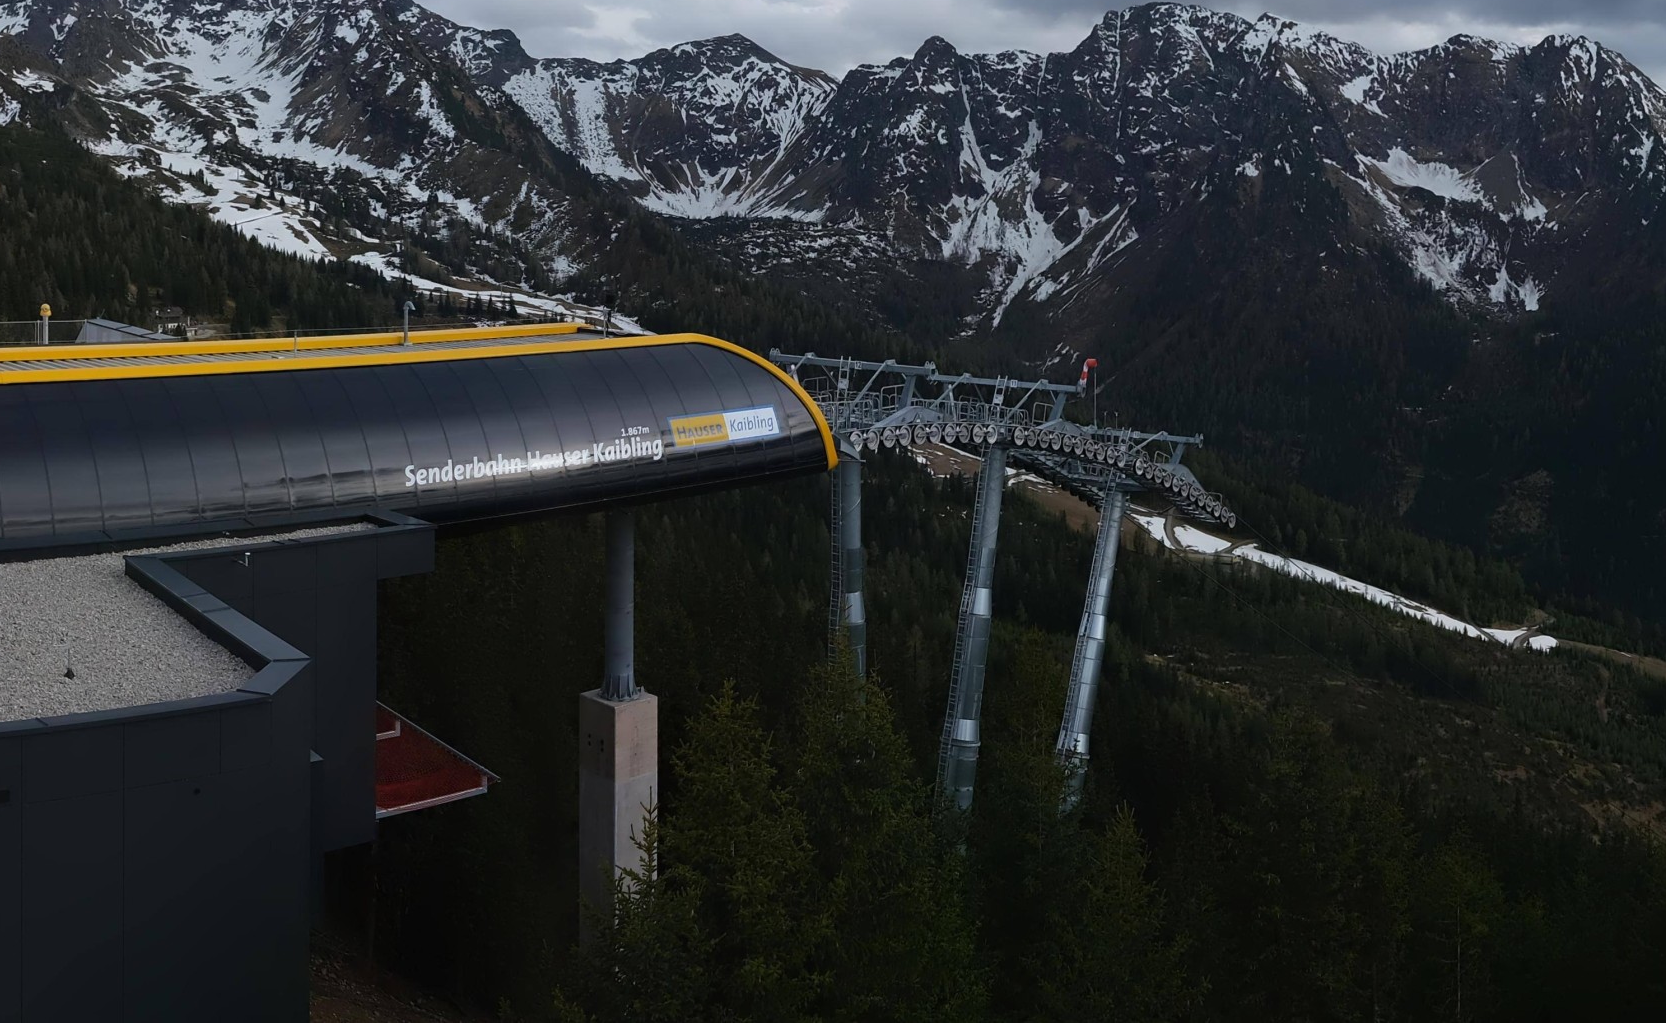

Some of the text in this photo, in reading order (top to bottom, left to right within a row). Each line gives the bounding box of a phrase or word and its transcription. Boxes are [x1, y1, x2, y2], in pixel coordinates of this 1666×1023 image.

[620, 426, 650, 437] 1.867m
[676, 415, 774, 439] HAUSER Kaibling
[405, 453, 522, 487] Senderbahn
[592, 437, 663, 463] Kaibling
